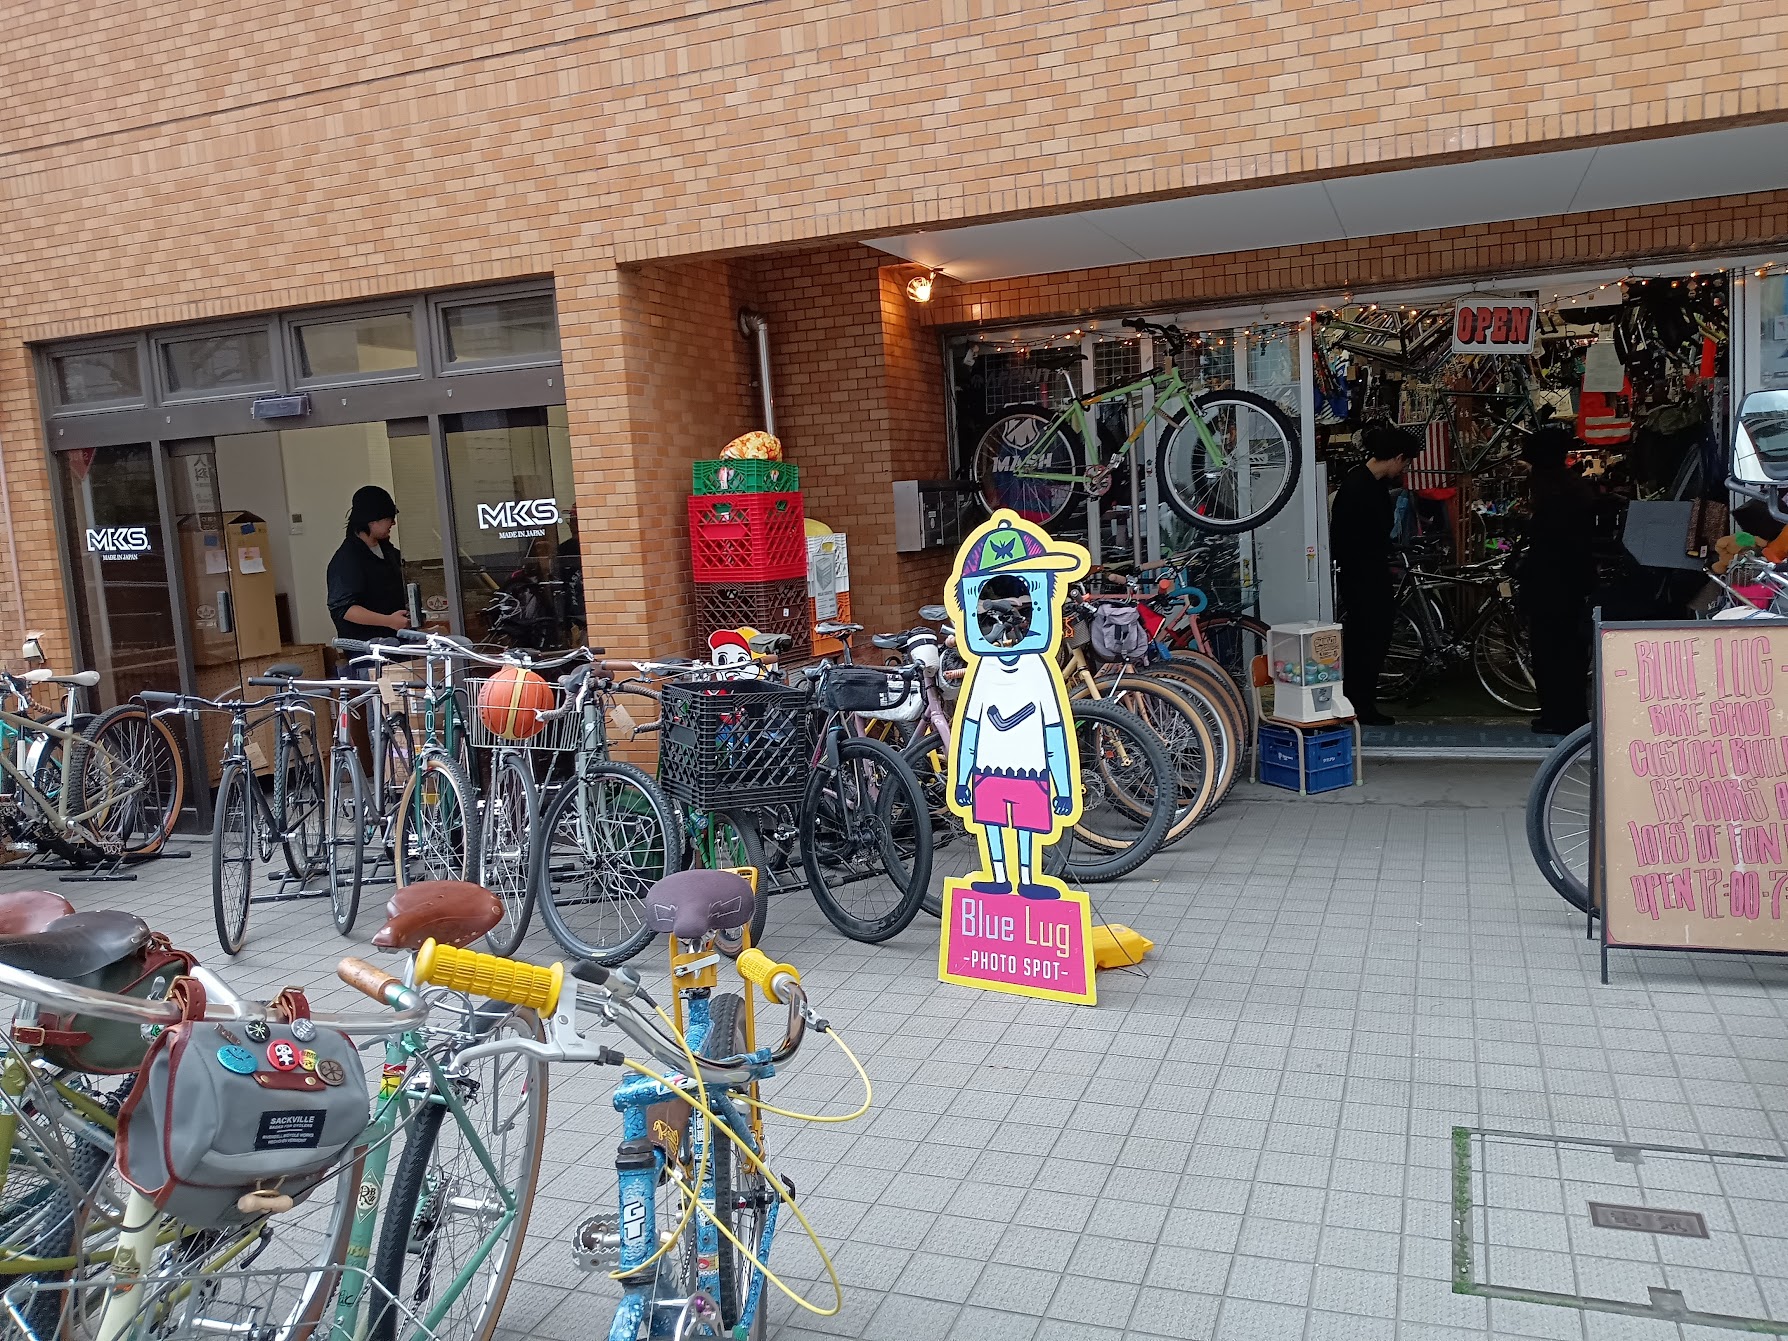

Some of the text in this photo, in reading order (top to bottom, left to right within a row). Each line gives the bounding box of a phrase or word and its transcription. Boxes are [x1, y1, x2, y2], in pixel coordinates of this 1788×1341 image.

[1457, 306, 1533, 345] OPEN
[477, 498, 560, 529] MKS
[86, 527, 149, 551] MKS
[499, 529, 545, 539] MADE IN JAPAN
[1634, 636, 1774, 702] BLUE LUG
[1648, 698, 1775, 737] BIKE SHOP
[1629, 738, 1728, 778] CUSTOM
[1650, 778, 1769, 822] REPAIRS
[1627, 821, 1782, 867] LOTS OF FUN
[1630, 868, 1696, 920] OPEN
[961, 898, 1070, 958] Blue Lug
[270, 1116, 315, 1125] SACKVILLE
[623, 1201, 646, 1241] GT
